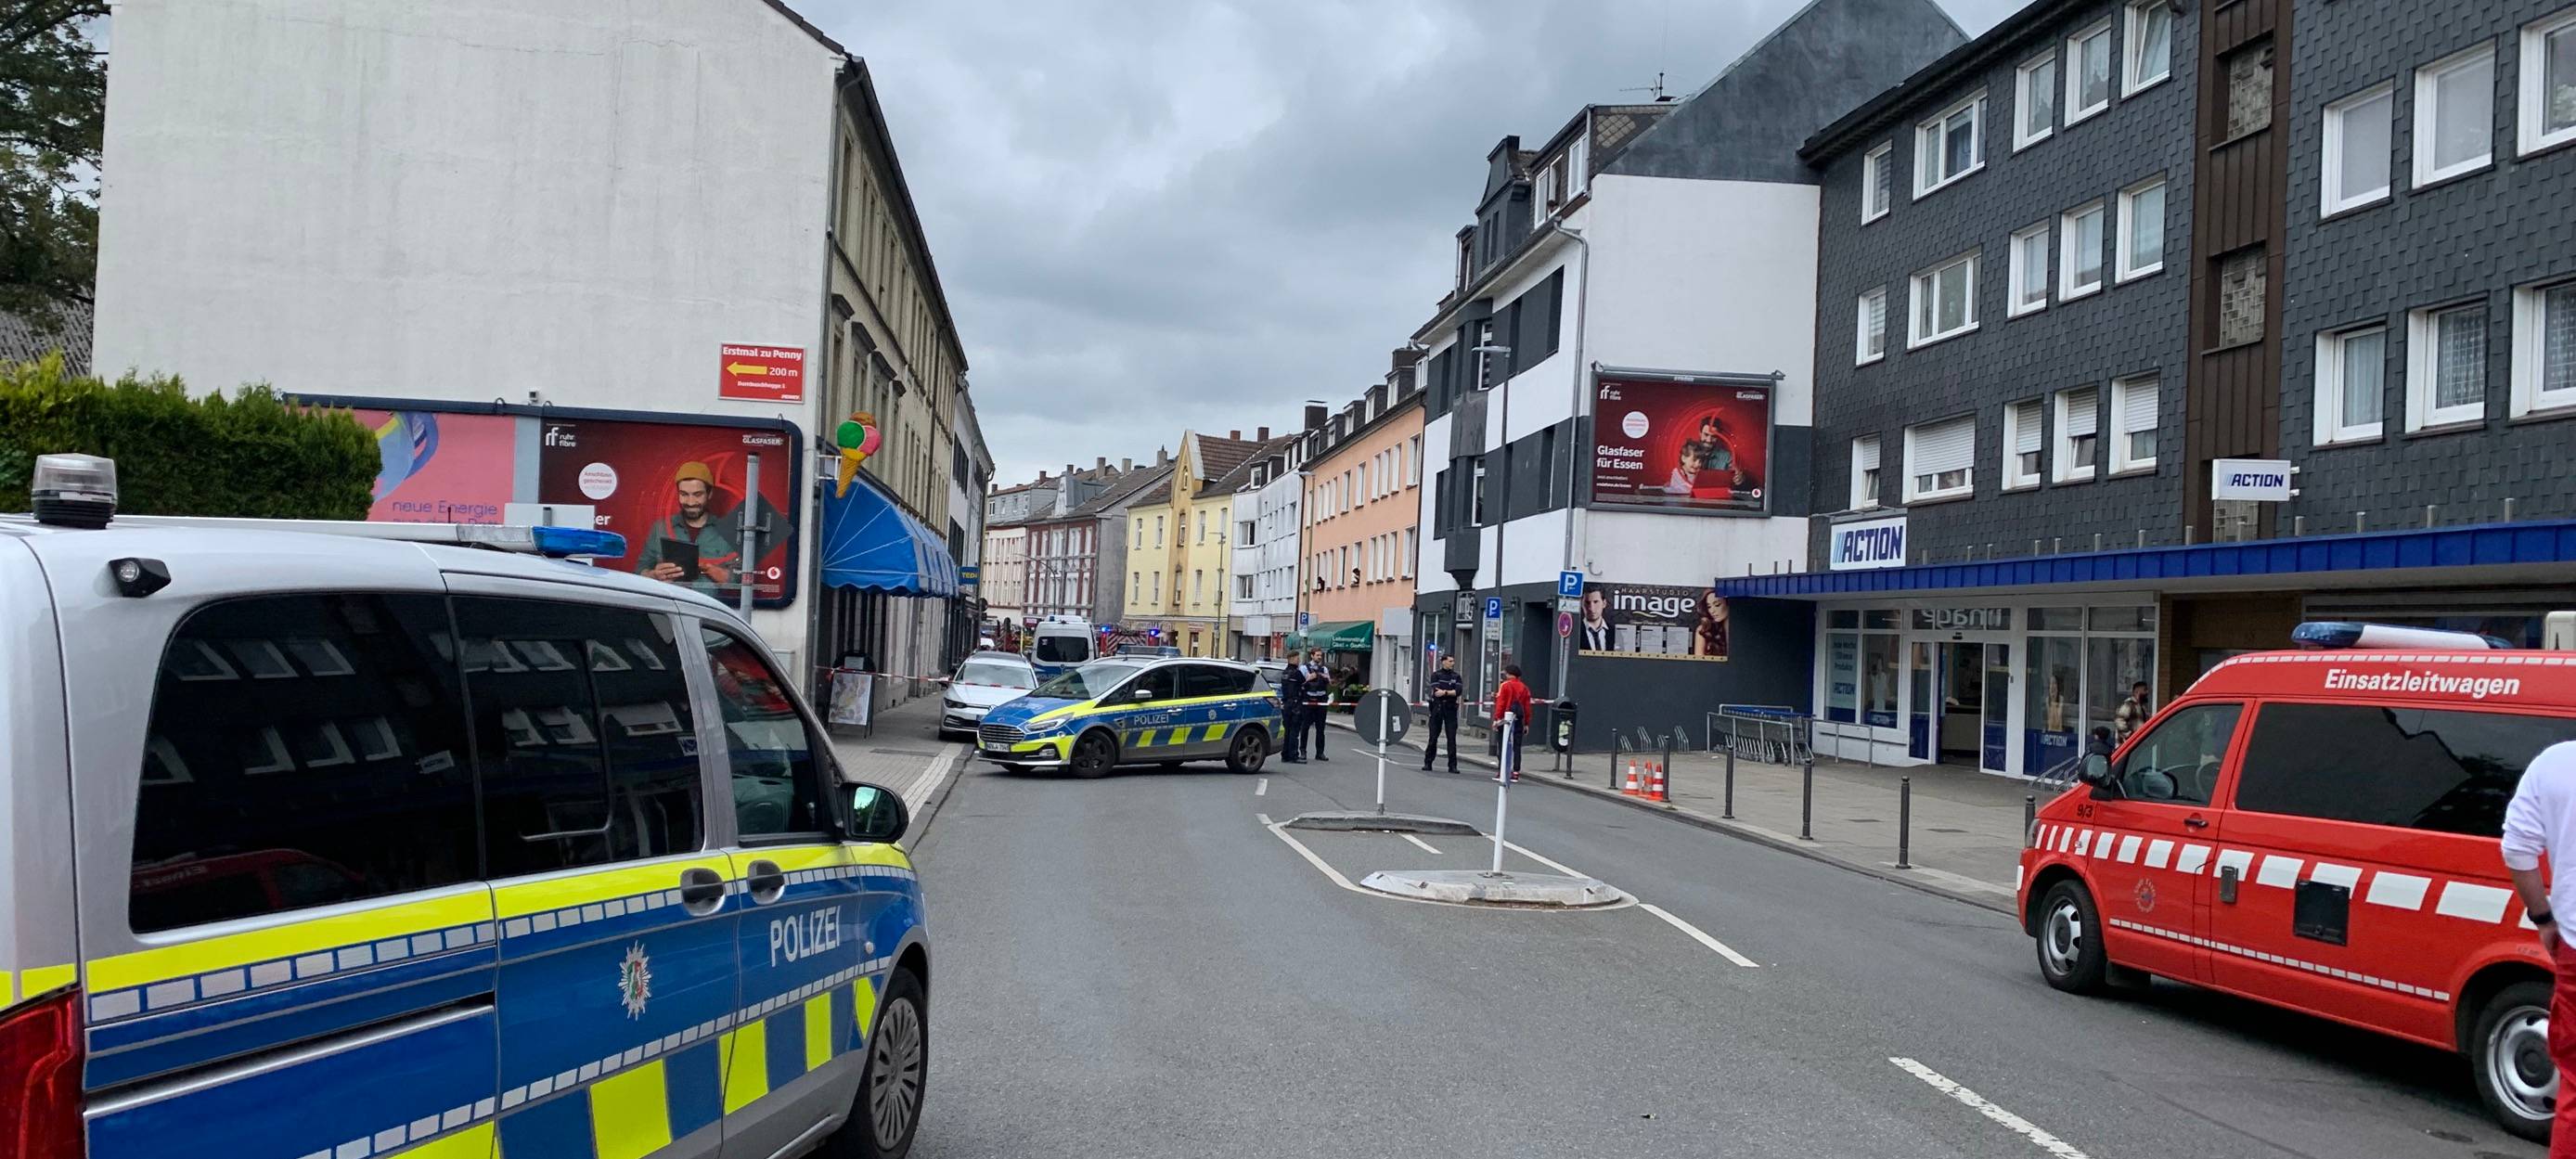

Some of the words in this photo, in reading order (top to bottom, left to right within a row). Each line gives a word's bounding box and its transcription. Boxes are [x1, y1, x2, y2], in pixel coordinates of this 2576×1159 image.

[723, 346, 758, 357] Erstmal
[773, 349, 802, 361] Penny
[769, 367, 787, 377] 200
[1597, 445, 1644, 457] Glasfaser
[1597, 458, 1611, 469] für
[1614, 459, 1643, 470] Essen
[2231, 474, 2284, 487] ACTION
[393, 501, 432, 512] neue
[438, 500, 498, 518] Energie
[1842, 525, 1903, 562] ACTION
[1565, 574, 1578, 592] P
[1621, 587, 1690, 597] HAARSTUDIO
[1489, 600, 1498, 616] P
[1614, 590, 1695, 618] image
[2325, 669, 2519, 699] Einsatzleitwagen
[1134, 714, 1169, 725] POLIZEI
[2077, 804, 2093, 818] 9/3
[770, 905, 841, 968] POLIZEI
